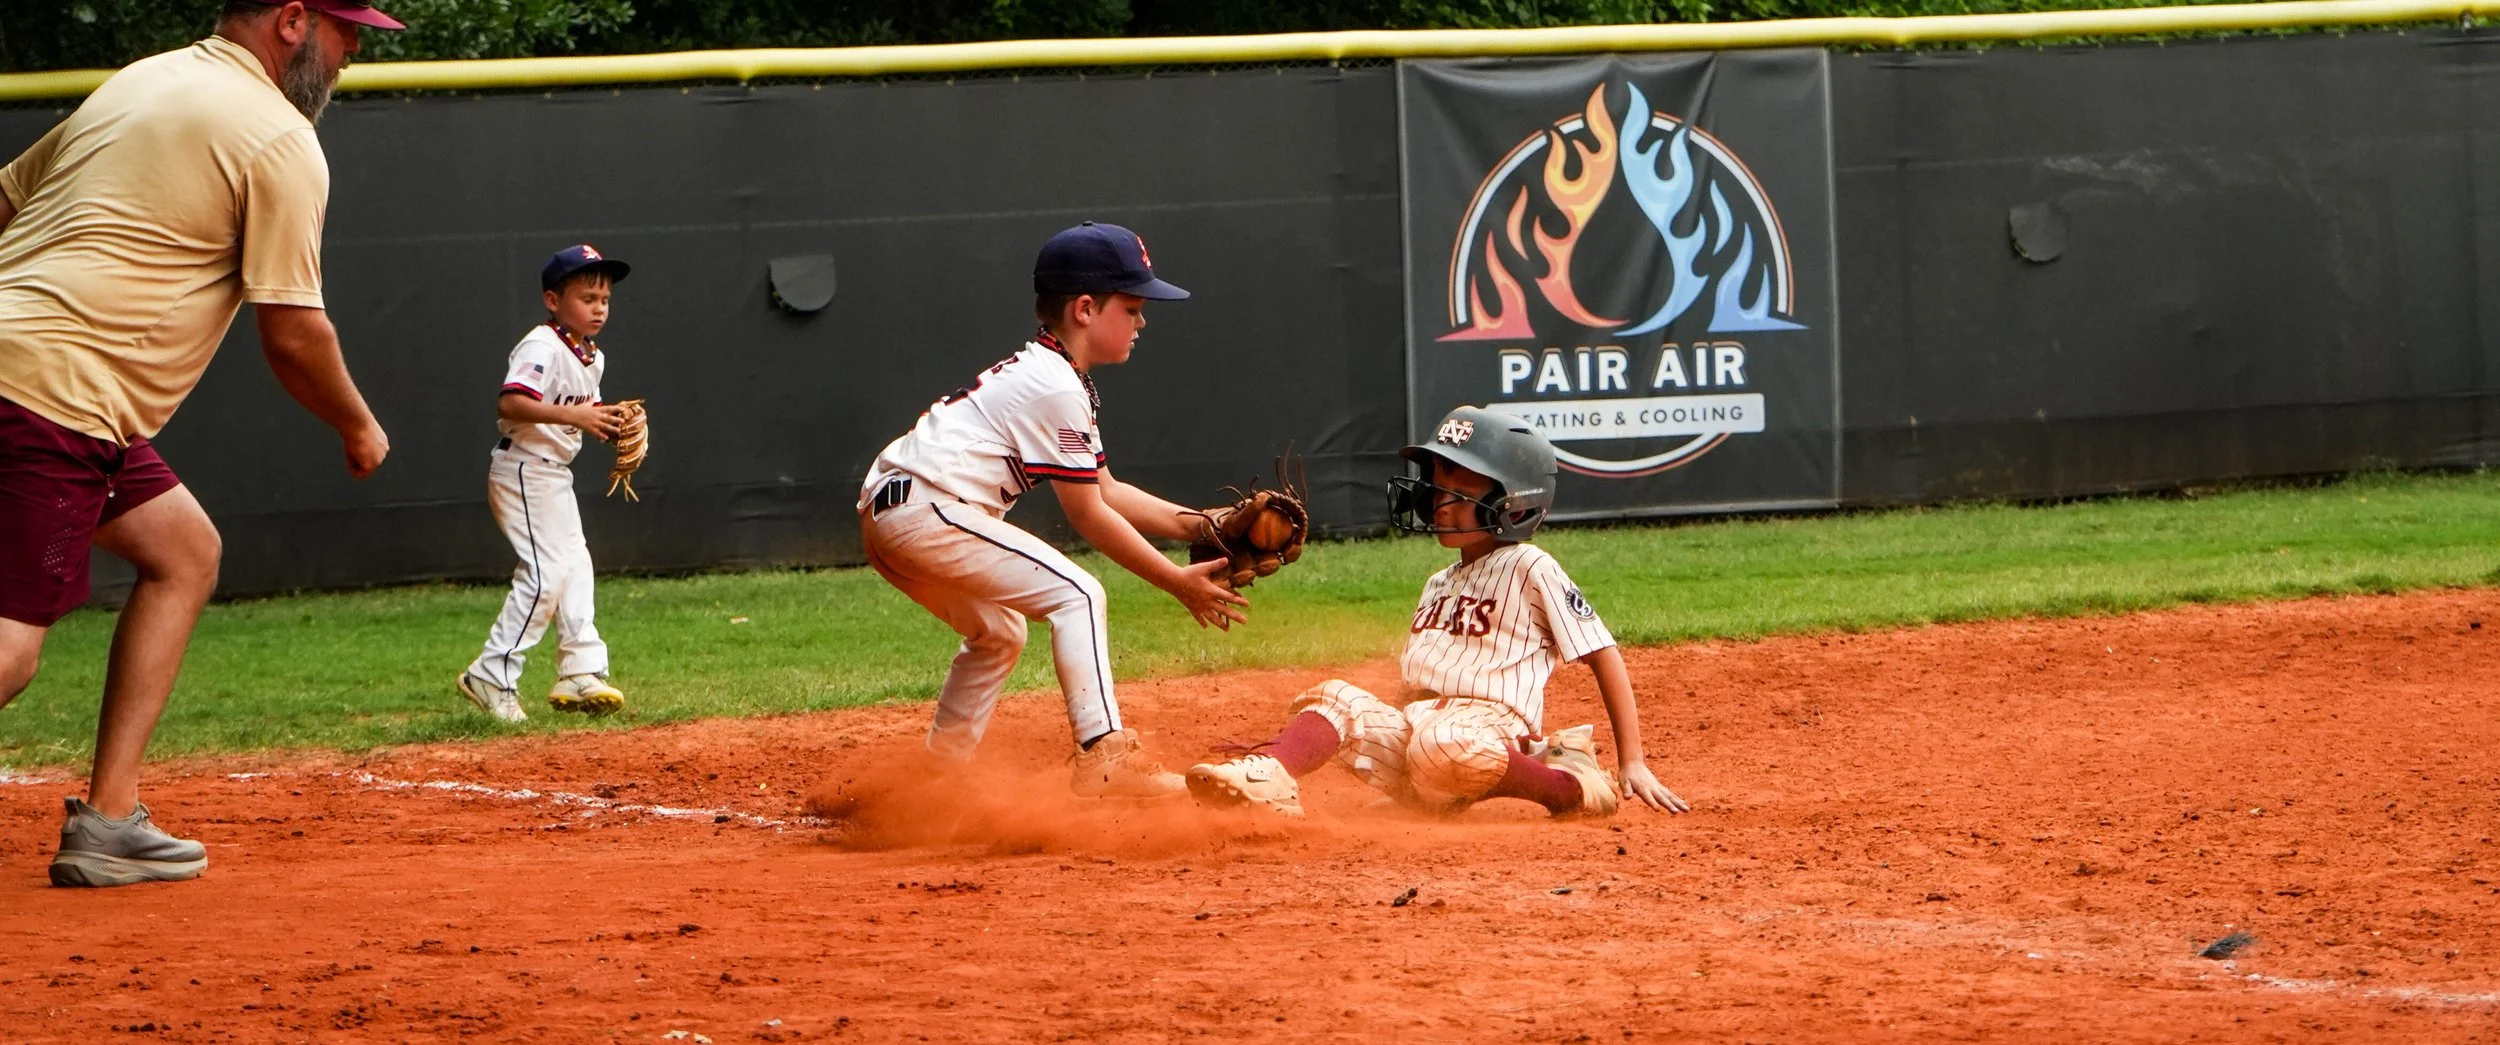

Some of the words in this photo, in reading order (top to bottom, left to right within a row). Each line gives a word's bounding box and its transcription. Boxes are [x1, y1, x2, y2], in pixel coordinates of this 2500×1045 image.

[1500, 348, 1629, 395] PAIR
[1651, 343, 1747, 390] AIR
[1614, 411, 1626, 426] &
[1639, 405, 1744, 425] COOLING
